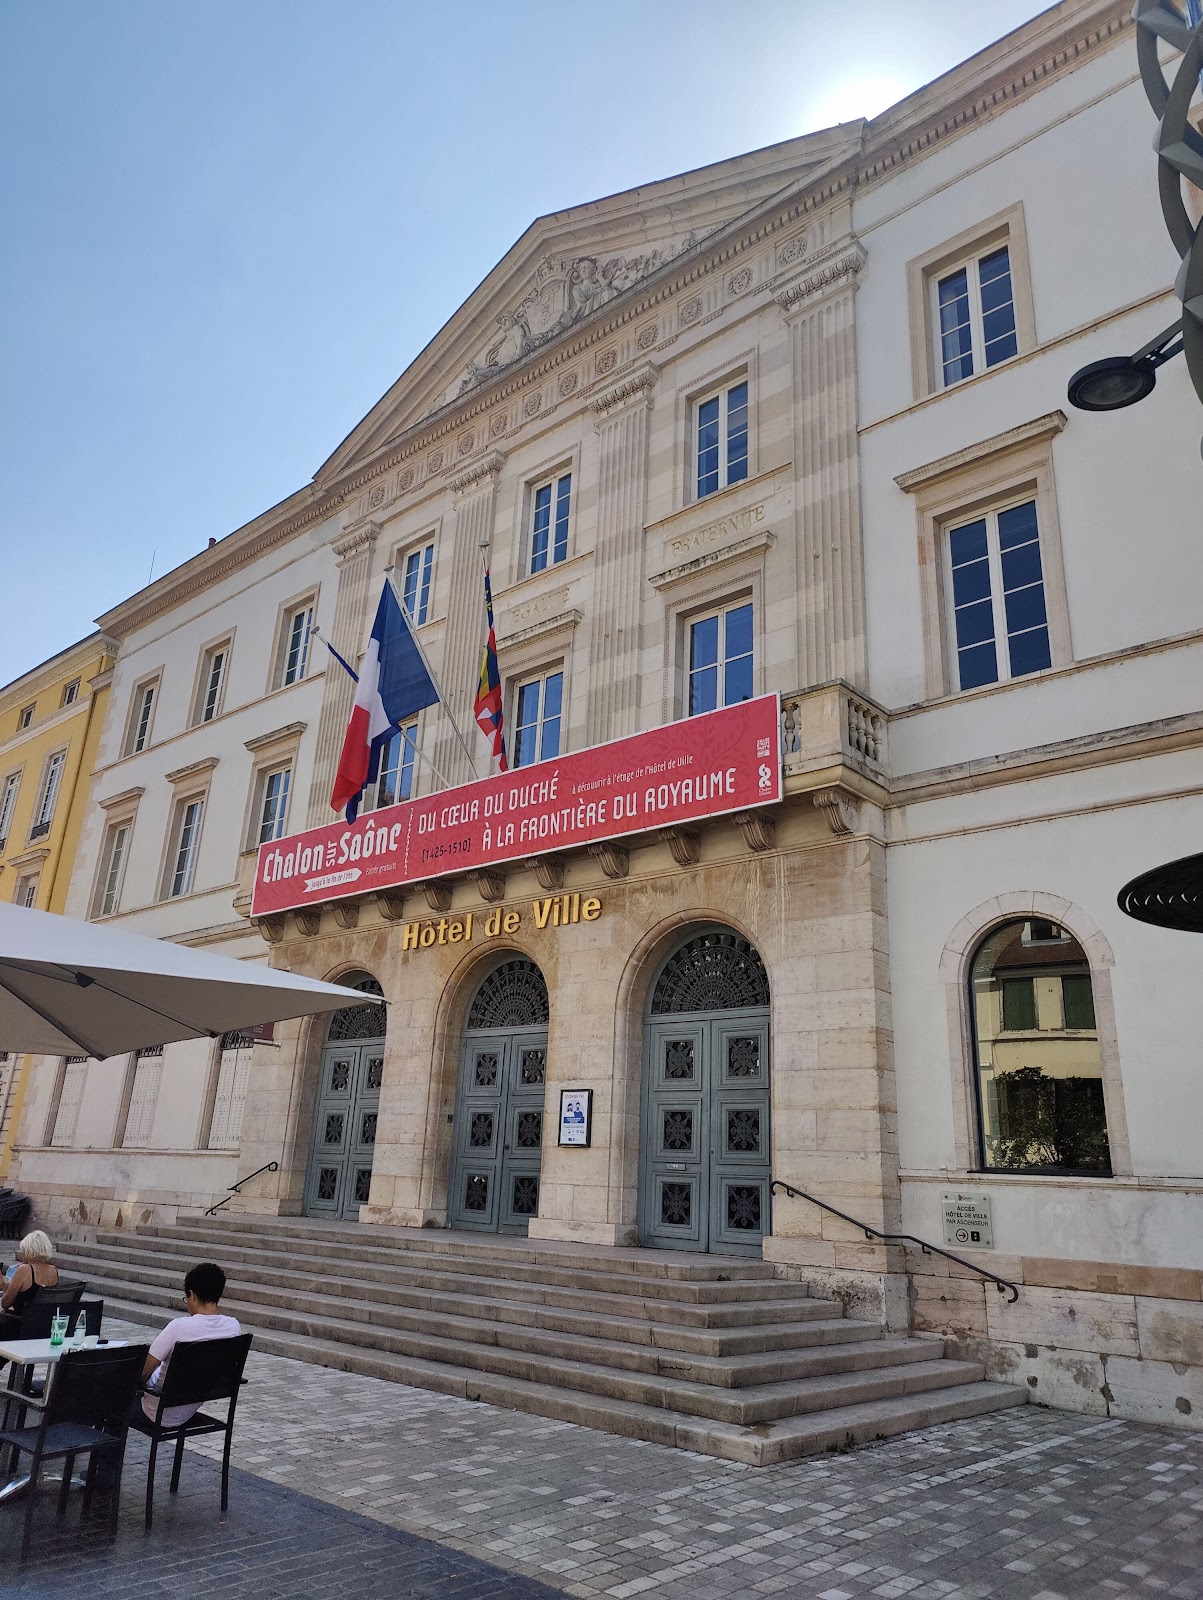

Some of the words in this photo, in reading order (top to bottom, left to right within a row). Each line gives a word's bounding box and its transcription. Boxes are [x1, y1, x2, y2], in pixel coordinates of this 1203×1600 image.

[418, 812, 436, 835] DU
[440, 800, 479, 828] CŒUR
[483, 792, 504, 817] DU
[508, 770, 560, 810] DUCHÉ
[577, 778, 606, 793] découvrir
[635, 768, 644, 777] de
[667, 758, 676, 770] de
[482, 822, 492, 851] À
[497, 822, 515, 848] LA
[519, 797, 607, 843] FRONTIÈRE
[613, 791, 638, 820] DU
[644, 767, 737, 813] ROYAUME
[263, 841, 325, 883] Chalon
[325, 840, 338, 868] sur
[337, 818, 402, 865] Saône
[402, 912, 473, 950] Hôtel
[484, 907, 521, 937] de
[532, 893, 603, 929] Ville
